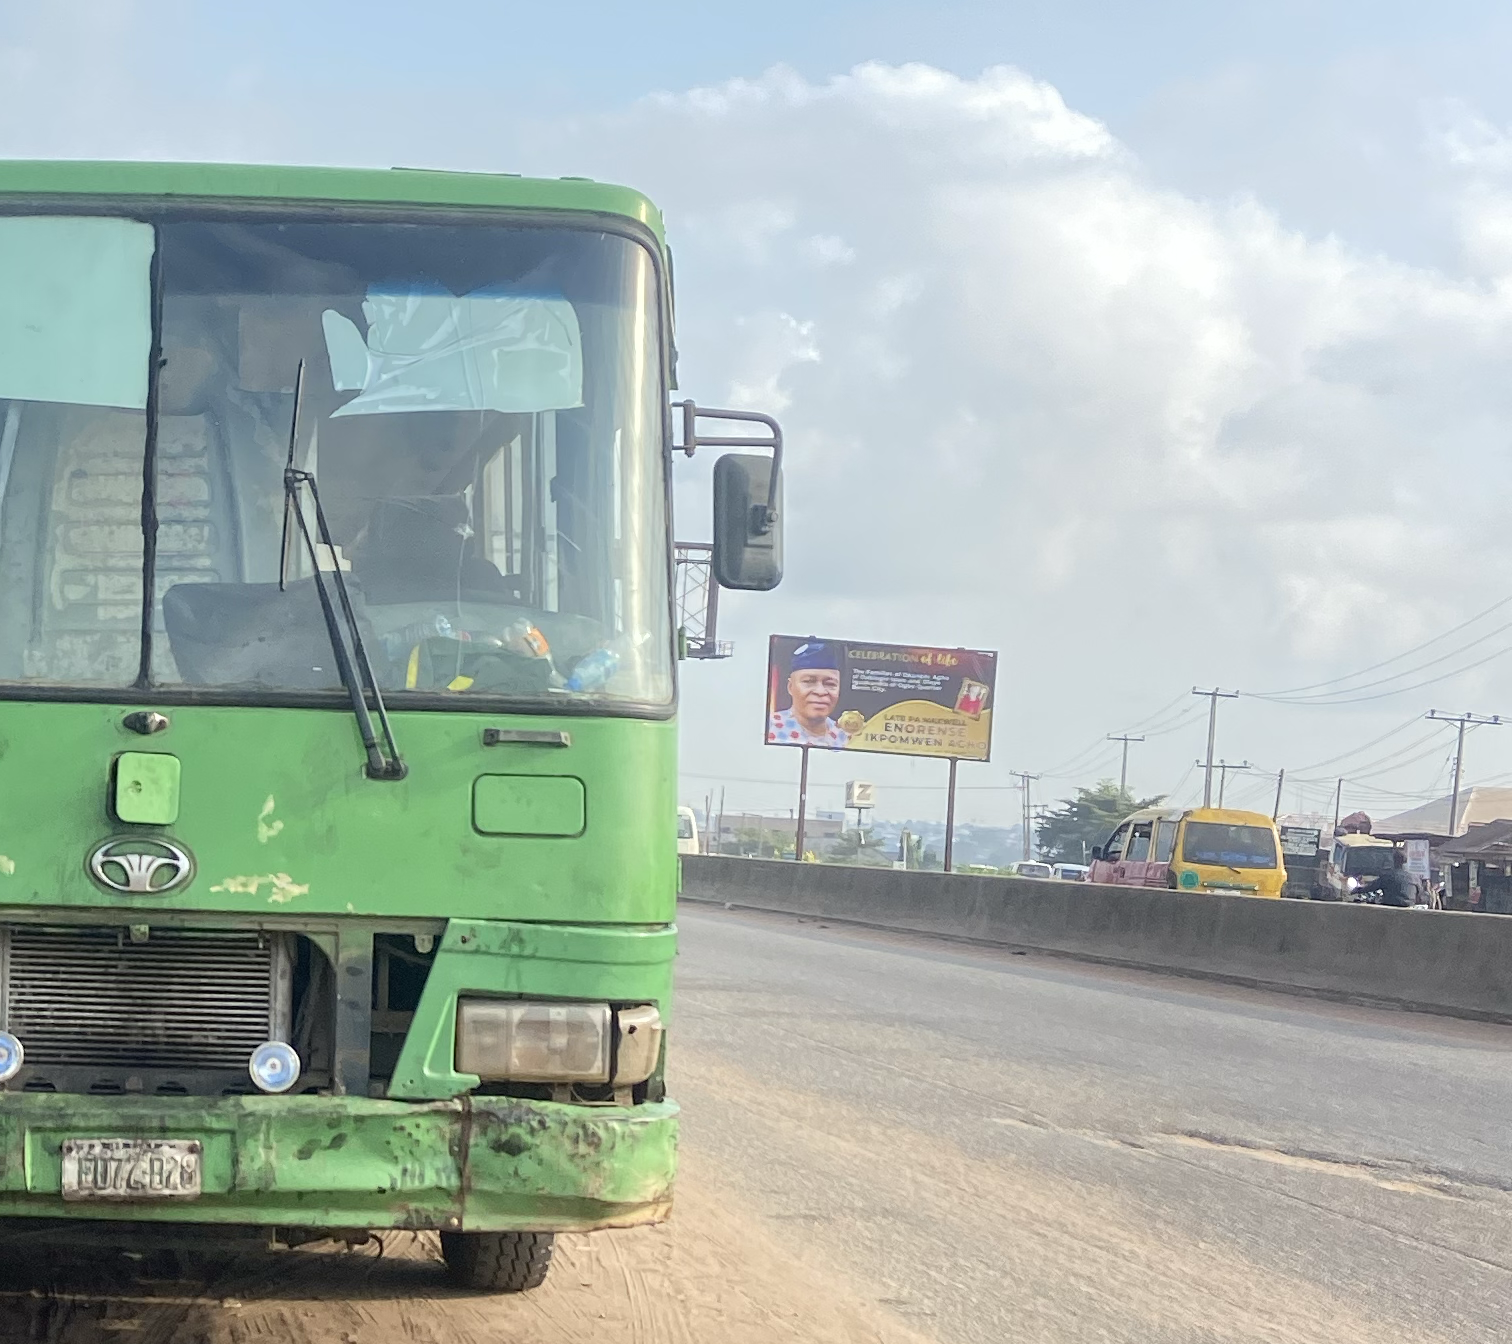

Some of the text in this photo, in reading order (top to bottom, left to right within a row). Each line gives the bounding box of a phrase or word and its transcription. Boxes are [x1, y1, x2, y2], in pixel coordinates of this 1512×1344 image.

[848, 650, 958, 667] CELEBRATION of life
[884, 714, 906, 722] LATE
[884, 722, 967, 737] ENORENSE
[864, 733, 943, 747] IKPOMWEN
